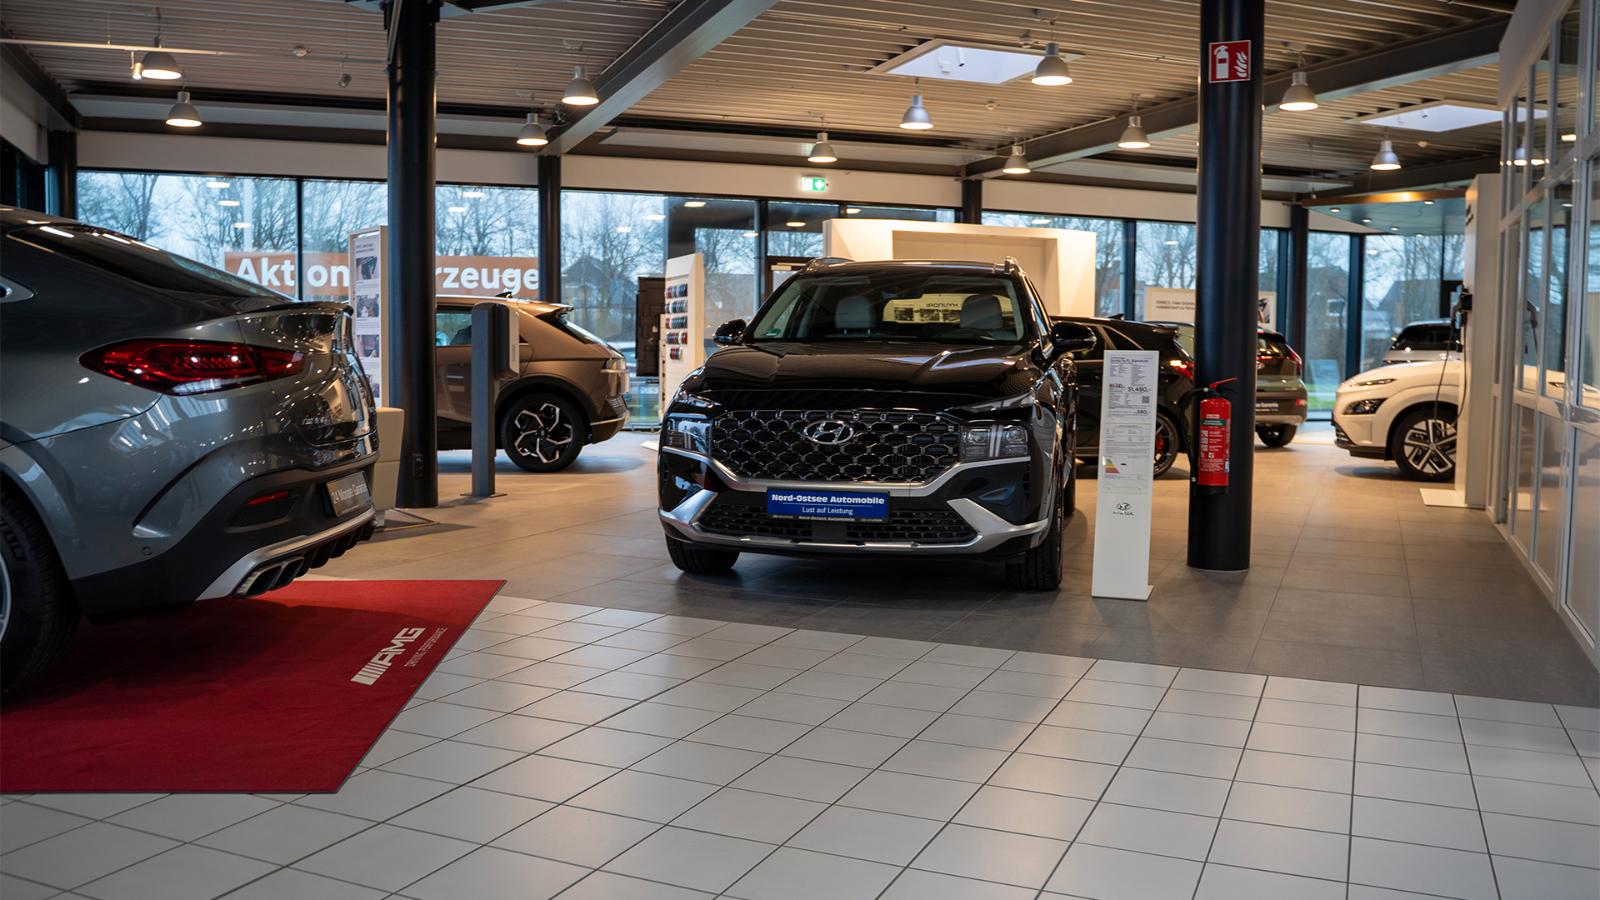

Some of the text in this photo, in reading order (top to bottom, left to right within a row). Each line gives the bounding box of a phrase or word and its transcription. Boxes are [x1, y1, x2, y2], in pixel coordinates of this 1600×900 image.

[771, 494, 885, 505] Nord-Ostsee Automobile
[827, 507, 854, 516] Leistung
